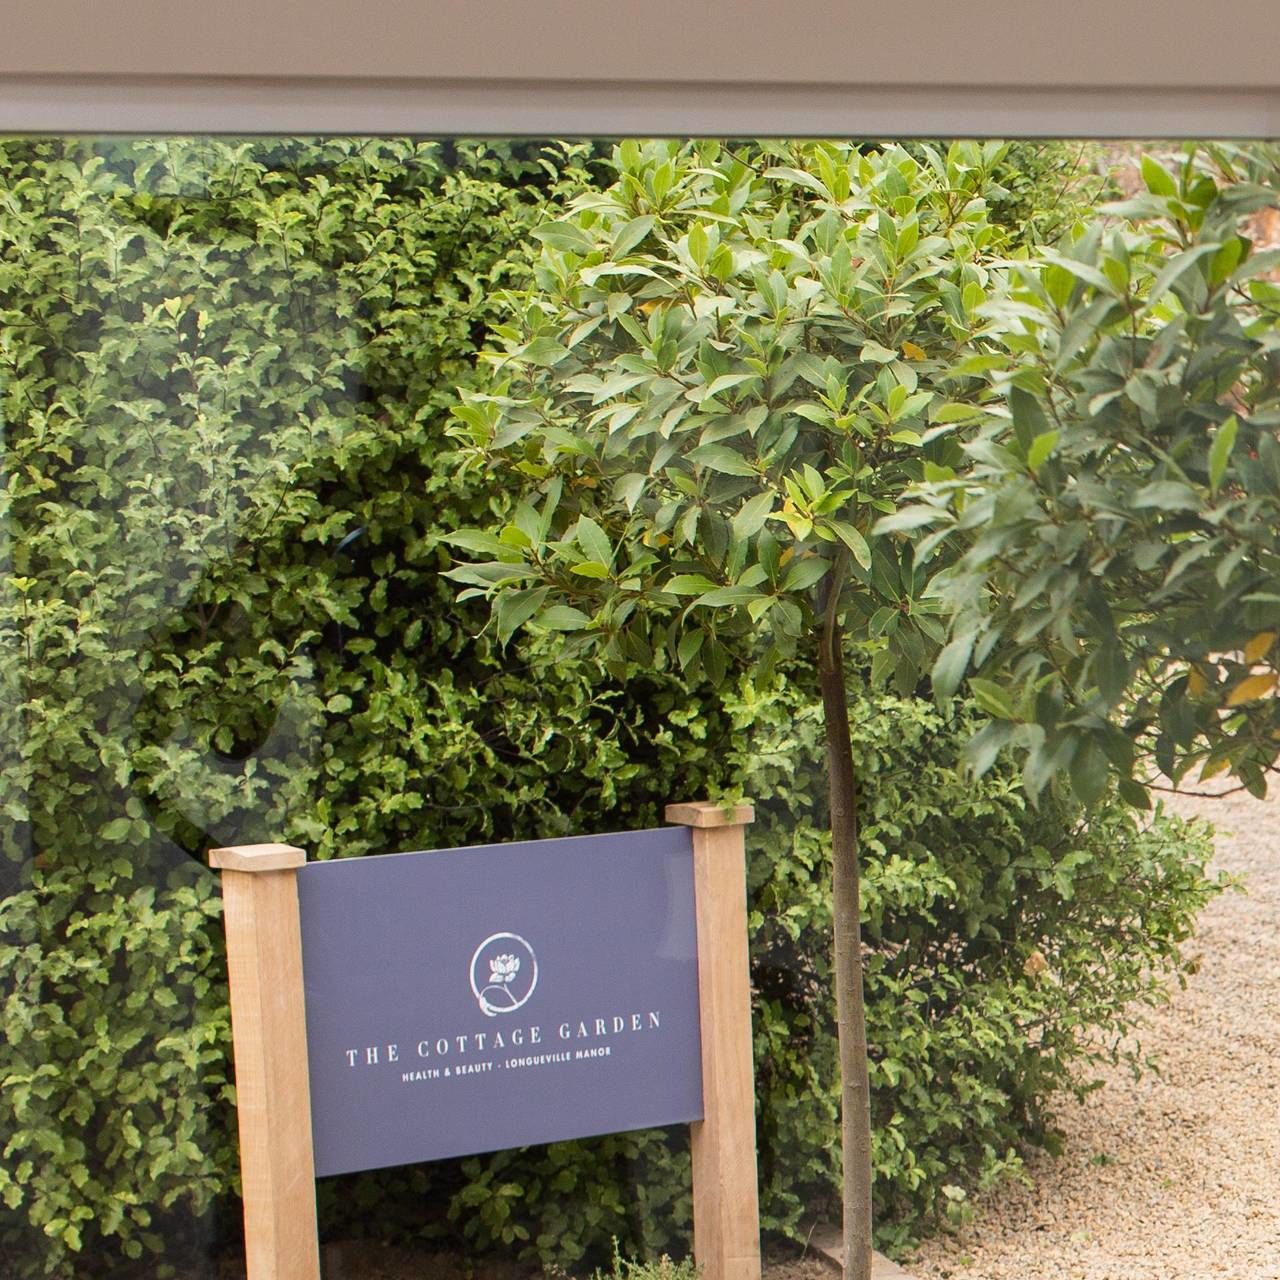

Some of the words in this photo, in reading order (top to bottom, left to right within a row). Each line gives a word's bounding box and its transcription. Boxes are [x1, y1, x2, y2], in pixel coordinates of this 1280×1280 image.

[346, 1044, 399, 1067] THE
[417, 1026, 541, 1058] COTTAGE
[559, 1011, 661, 1040] GARDEN
[402, 1068, 440, 1082] HEALTH
[444, 1067, 451, 1077] &
[455, 1062, 493, 1075] BEAUTY
[505, 1051, 571, 1069] LONGUEVILLE
[576, 1046, 611, 1059] MANOR
